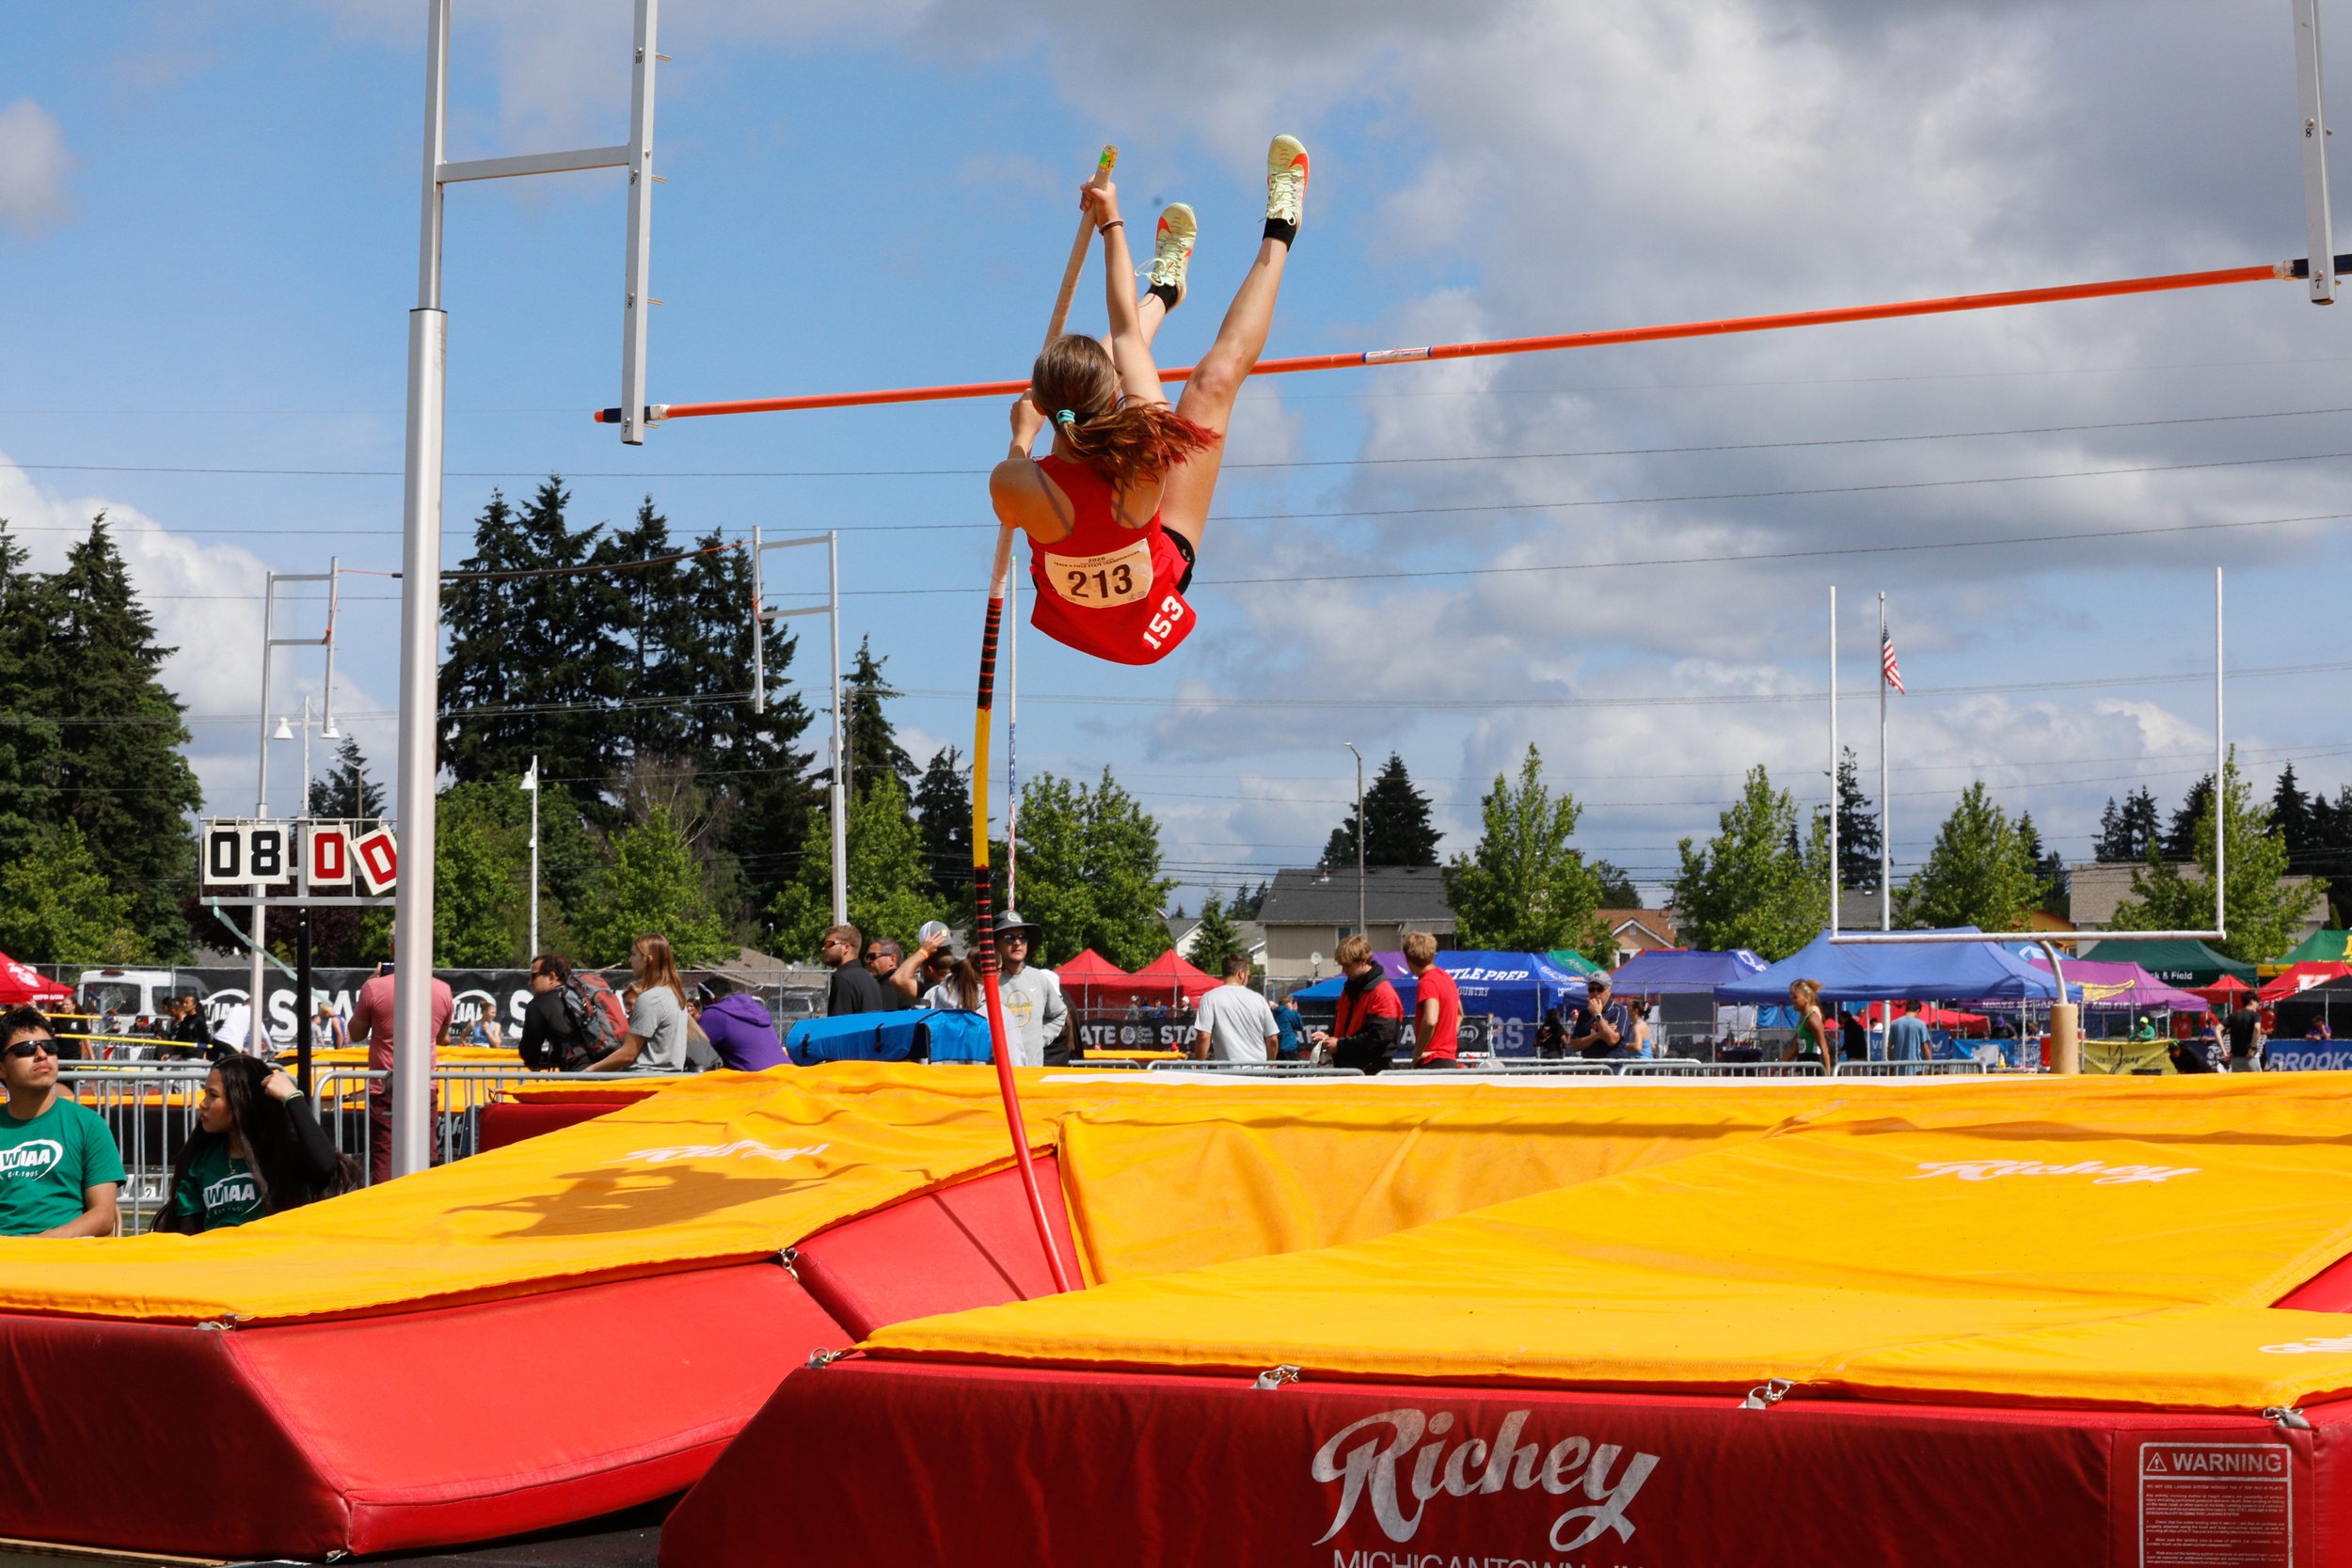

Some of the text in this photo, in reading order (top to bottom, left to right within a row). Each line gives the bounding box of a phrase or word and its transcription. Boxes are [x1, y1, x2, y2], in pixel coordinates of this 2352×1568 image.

[1068, 564, 1133, 598] 213
[1143, 595, 1184, 650] 153
[210, 831, 281, 878] 08
[1483, 970, 1529, 981] PREP
[2171, 972, 2193, 980] Field
[1458, 986, 1490, 997] OUNTRY
[1080, 1025, 1117, 1045] ATE
[1160, 1024, 1198, 1045] STA
[2268, 1052, 2352, 1071] BROOK
[3, 1148, 51, 1168] WIAA
[1901, 1160, 2203, 1184] Richey
[206, 1183, 256, 1205] WIAA
[2172, 1452, 2282, 1472] WARNING
[1312, 1409, 1661, 1552] Richey
